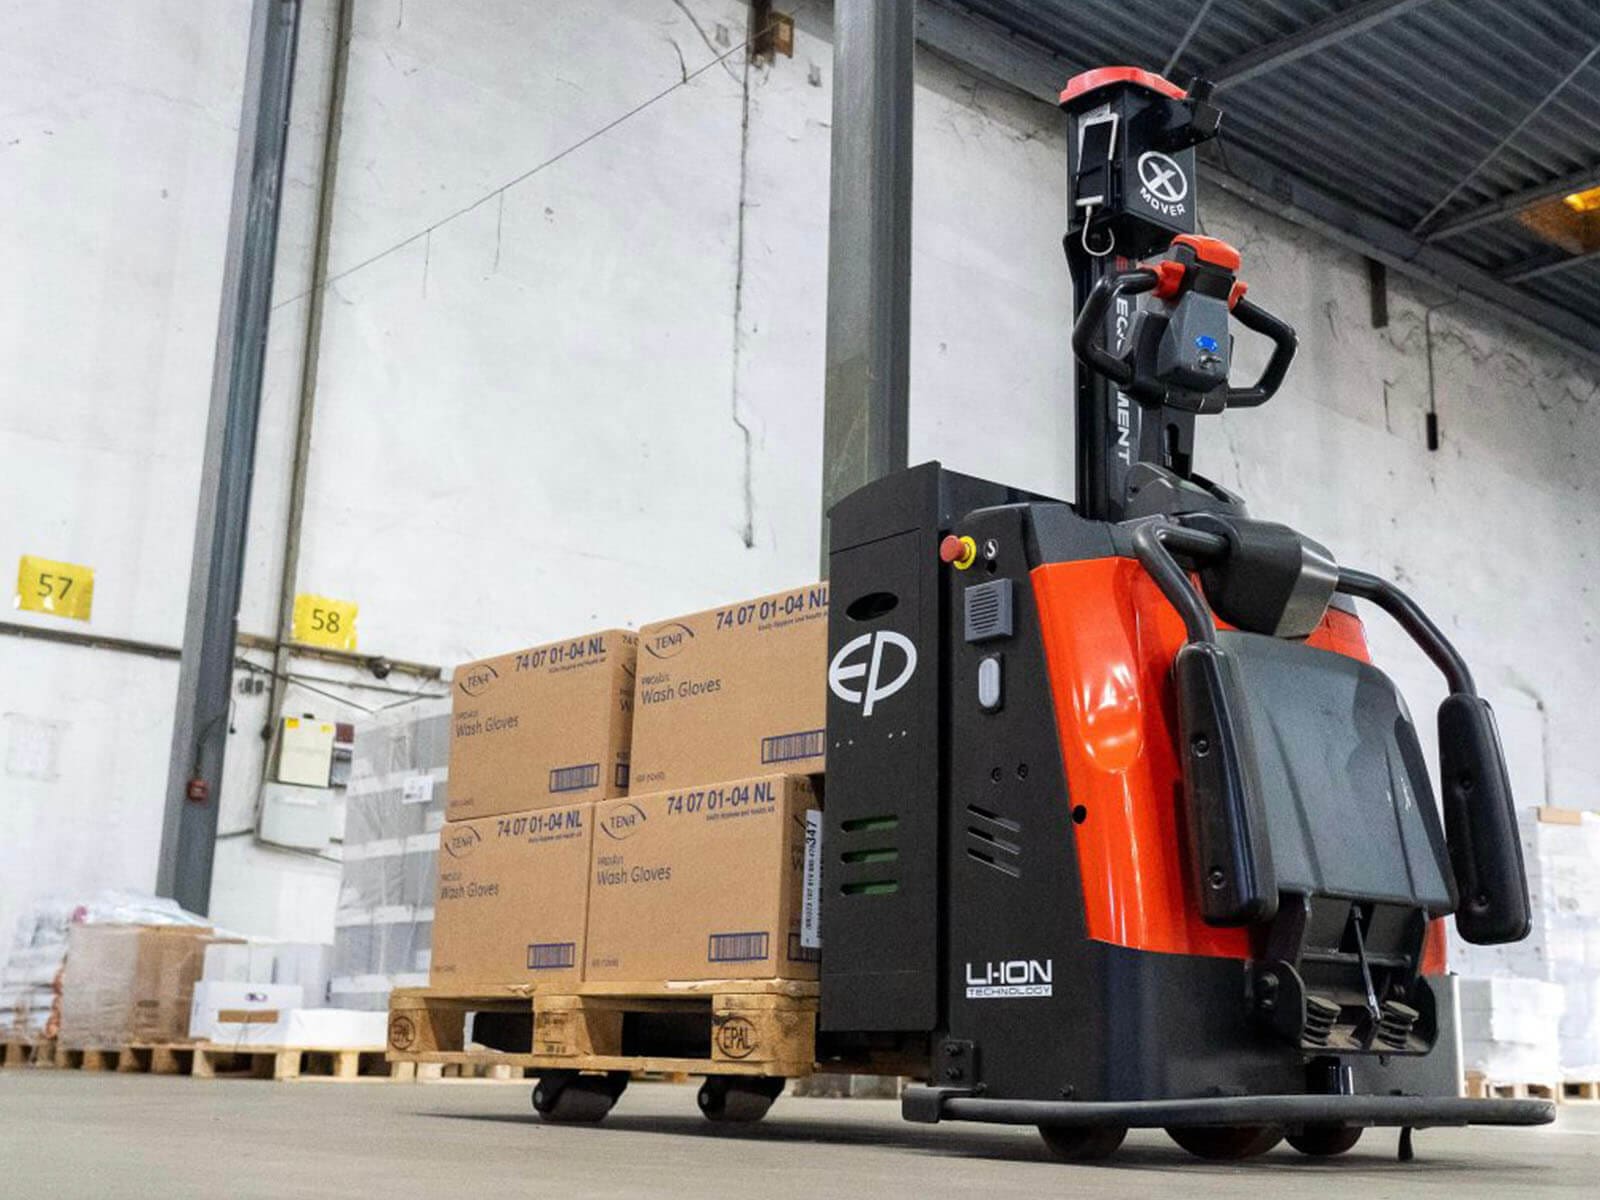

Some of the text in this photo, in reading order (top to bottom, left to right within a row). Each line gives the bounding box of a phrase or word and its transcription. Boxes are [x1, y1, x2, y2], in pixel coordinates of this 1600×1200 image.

[1140, 186, 1186, 216] MOVER
[1115, 296, 1131, 467] EQMENT
[38, 573, 73, 600] 57
[312, 608, 340, 633] 58
[716, 610, 733, 631] 74
[737, 605, 756, 625] 07
[760, 593, 804, 620] 01-04
[809, 587, 829, 610] NL
[515, 655, 530, 673] 74
[532, 650, 547, 669] 07
[550, 641, 585, 664] 01-04
[588, 636, 607, 656] NL
[655, 633, 683, 650] TENA
[828, 630, 918, 717] EP
[641, 686, 674, 705] Wash
[678, 679, 721, 698] Gloves
[456, 719, 482, 738] Wash
[485, 715, 519, 732] Gloves
[667, 795, 683, 815] 74
[687, 792, 704, 813] 07
[708, 786, 749, 809] 01-04
[754, 782, 775, 803] NL
[497, 810, 582, 837] 74 07 01-04 NL
[610, 814, 635, 829] TENA
[806, 820, 817, 845] 347
[597, 865, 671, 886] Wash Gloves
[441, 882, 499, 900] Wash Gloves
[966, 959, 1052, 985] LI-ION
[968, 986, 1051, 997] TECHNOLOGY
[723, 1026, 751, 1050] EPAL
